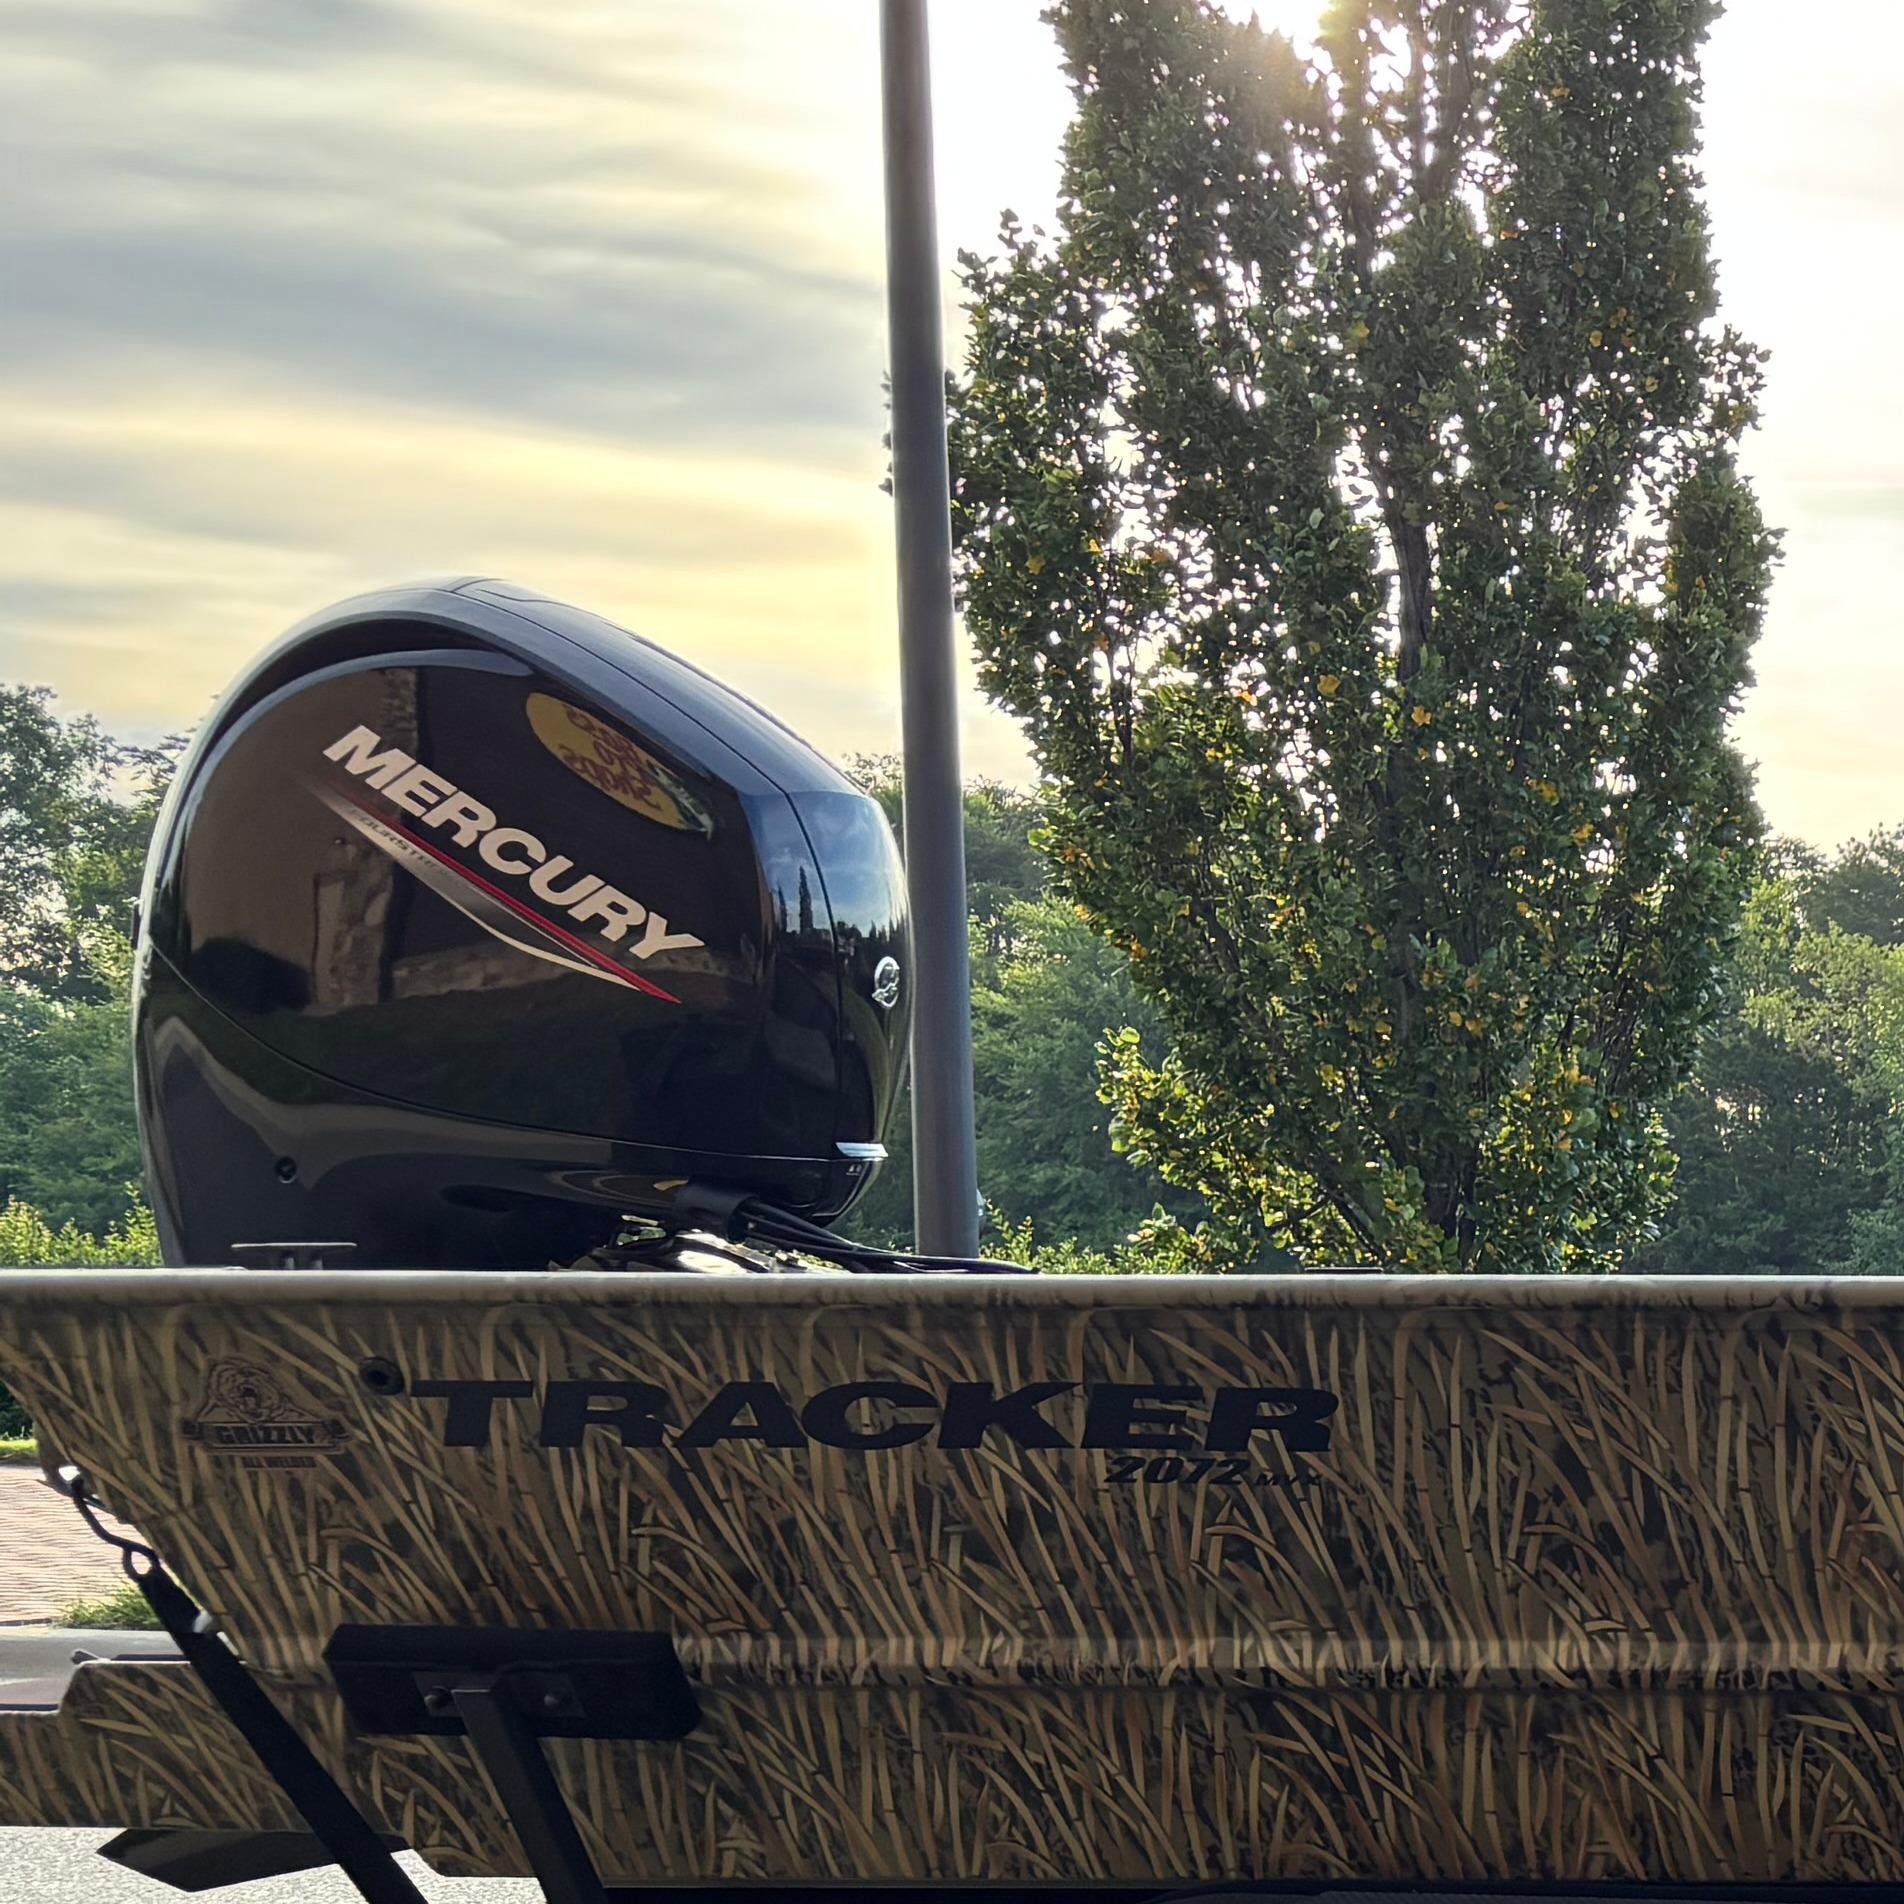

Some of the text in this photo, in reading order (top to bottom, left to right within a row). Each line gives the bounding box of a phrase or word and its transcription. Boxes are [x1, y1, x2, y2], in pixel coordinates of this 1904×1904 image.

[322, 724, 705, 960] MERCURY
[347, 808, 454, 884] FOURSTRO
[214, 1424, 317, 1445] GRIZZLY
[410, 1379, 1341, 1452] TRACKER
[1103, 1456, 1253, 1485] 2072
